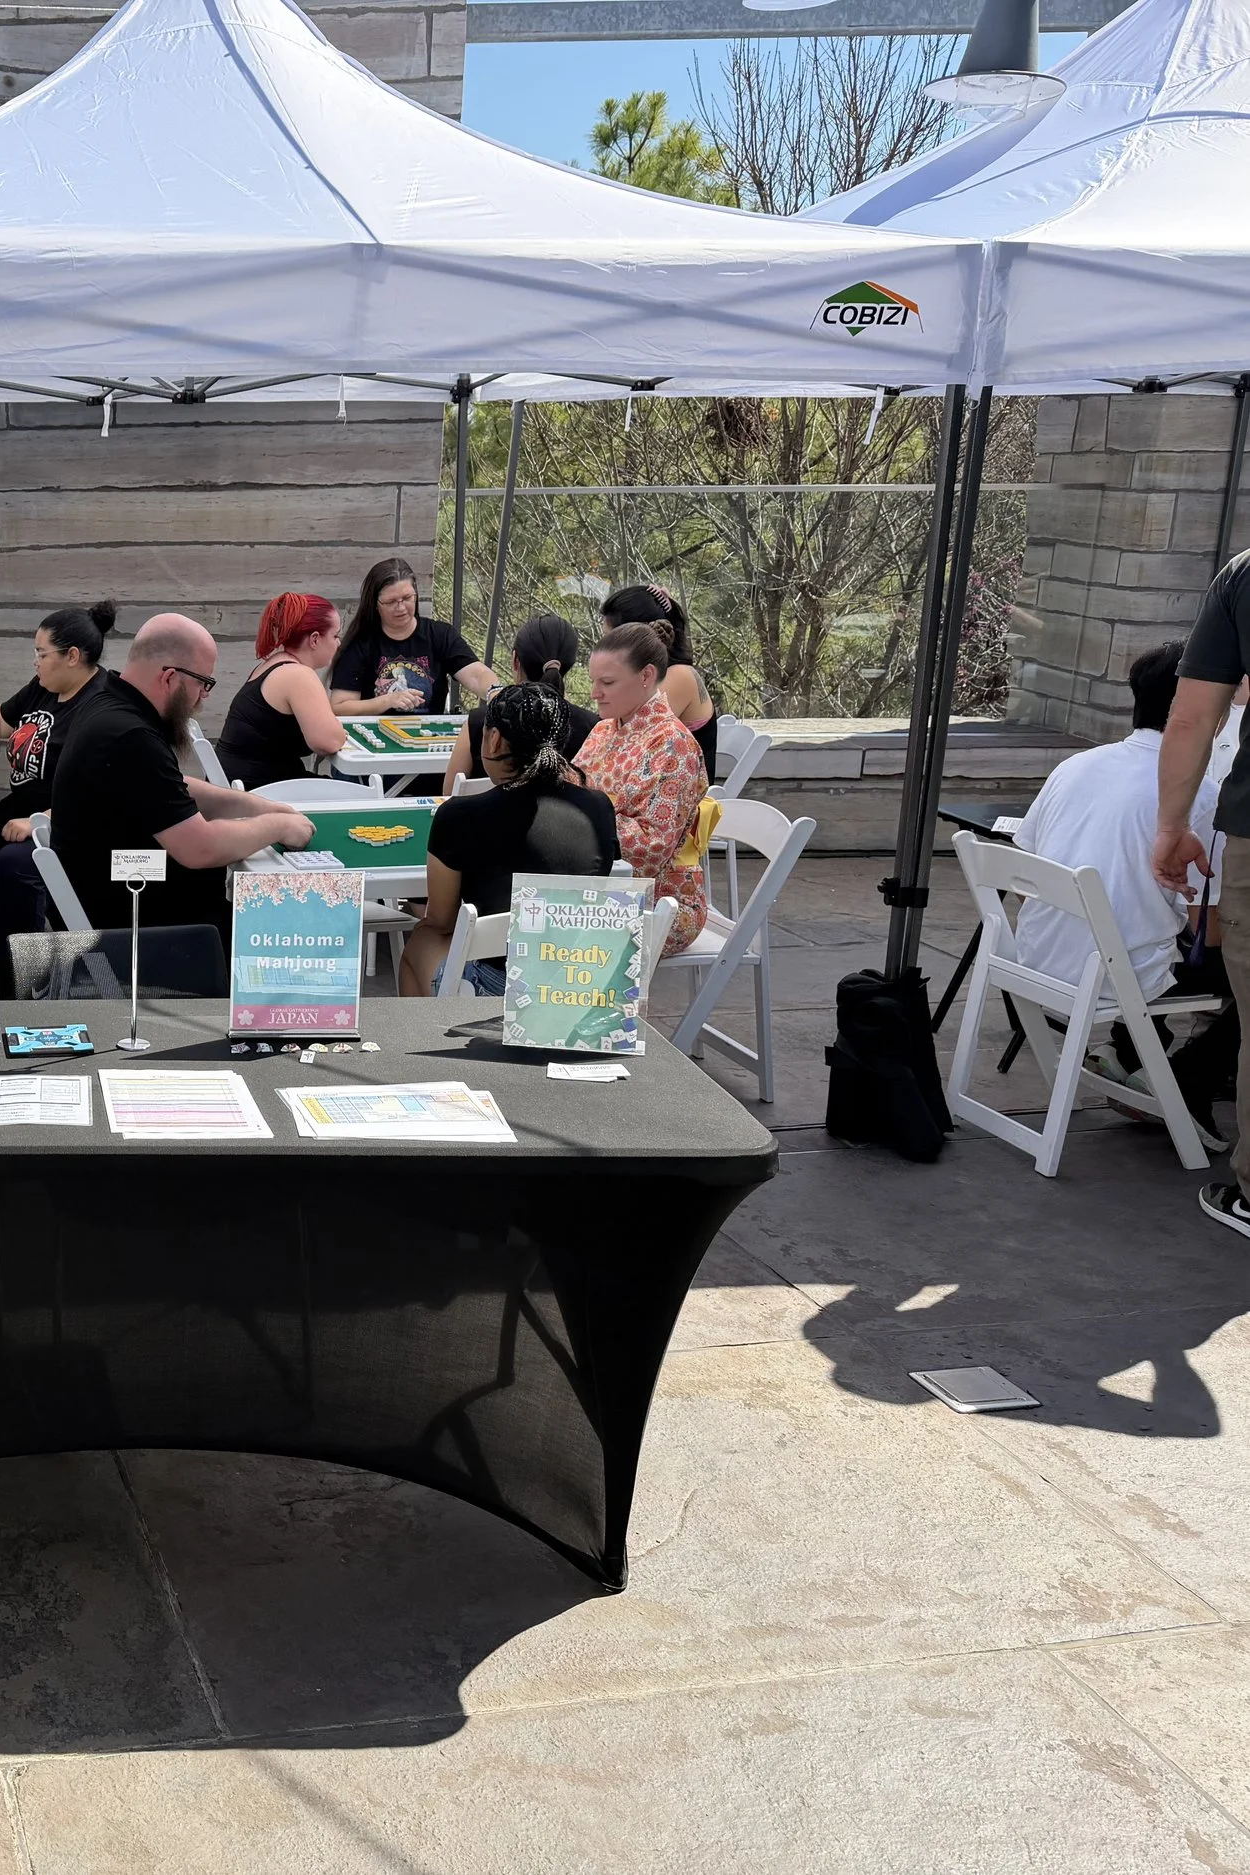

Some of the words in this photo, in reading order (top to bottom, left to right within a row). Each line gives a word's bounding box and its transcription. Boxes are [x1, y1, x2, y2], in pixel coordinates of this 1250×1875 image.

[823, 305, 909, 325] COBIZI
[545, 904, 631, 918] OKLAHOMA
[551, 914, 624, 930] MAHJONG
[250, 933, 344, 947] Oklahoma
[256, 955, 336, 972] Mahjong
[539, 942, 612, 968] Ready
[563, 965, 592, 985] To
[536, 984, 616, 1008] Teach!
[268, 1012, 318, 1024] JAPAN
